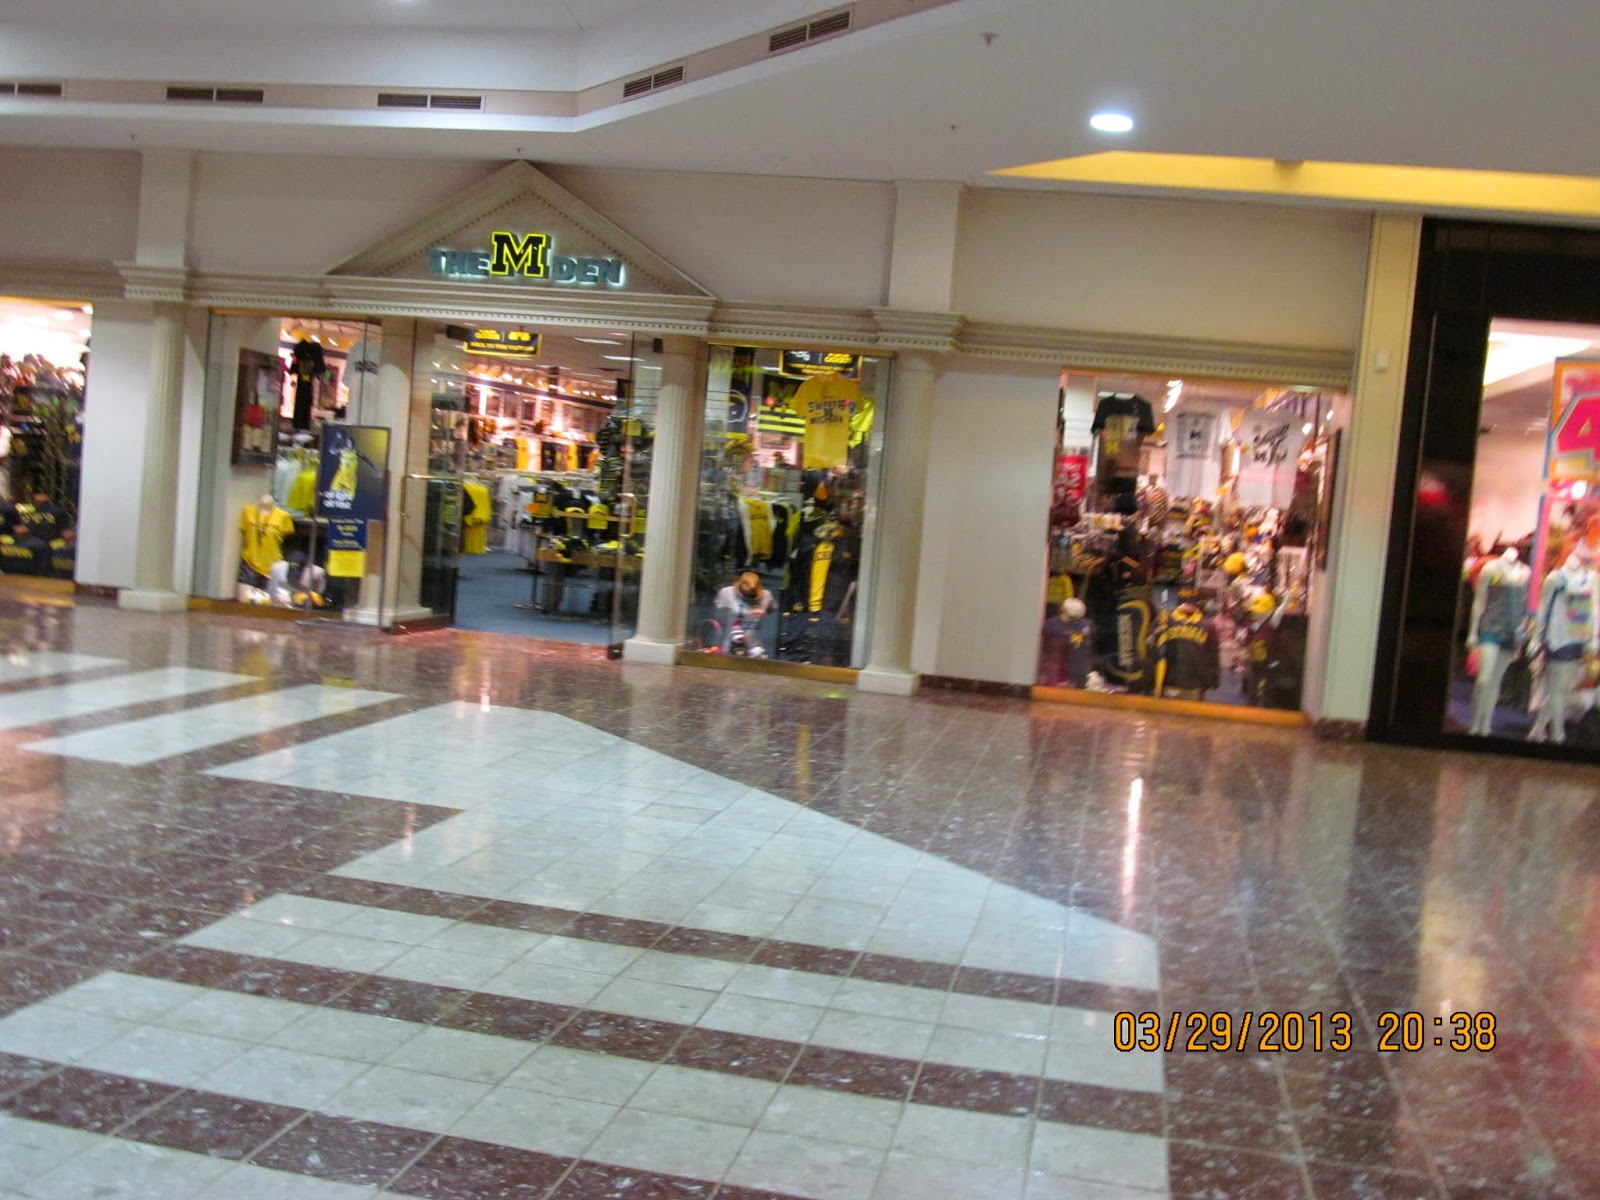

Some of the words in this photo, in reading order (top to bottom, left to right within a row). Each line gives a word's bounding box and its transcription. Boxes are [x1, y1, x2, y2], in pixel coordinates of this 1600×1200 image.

[428, 249, 490, 276] THE
[489, 231, 552, 279] M
[552, 255, 624, 286] DEN
